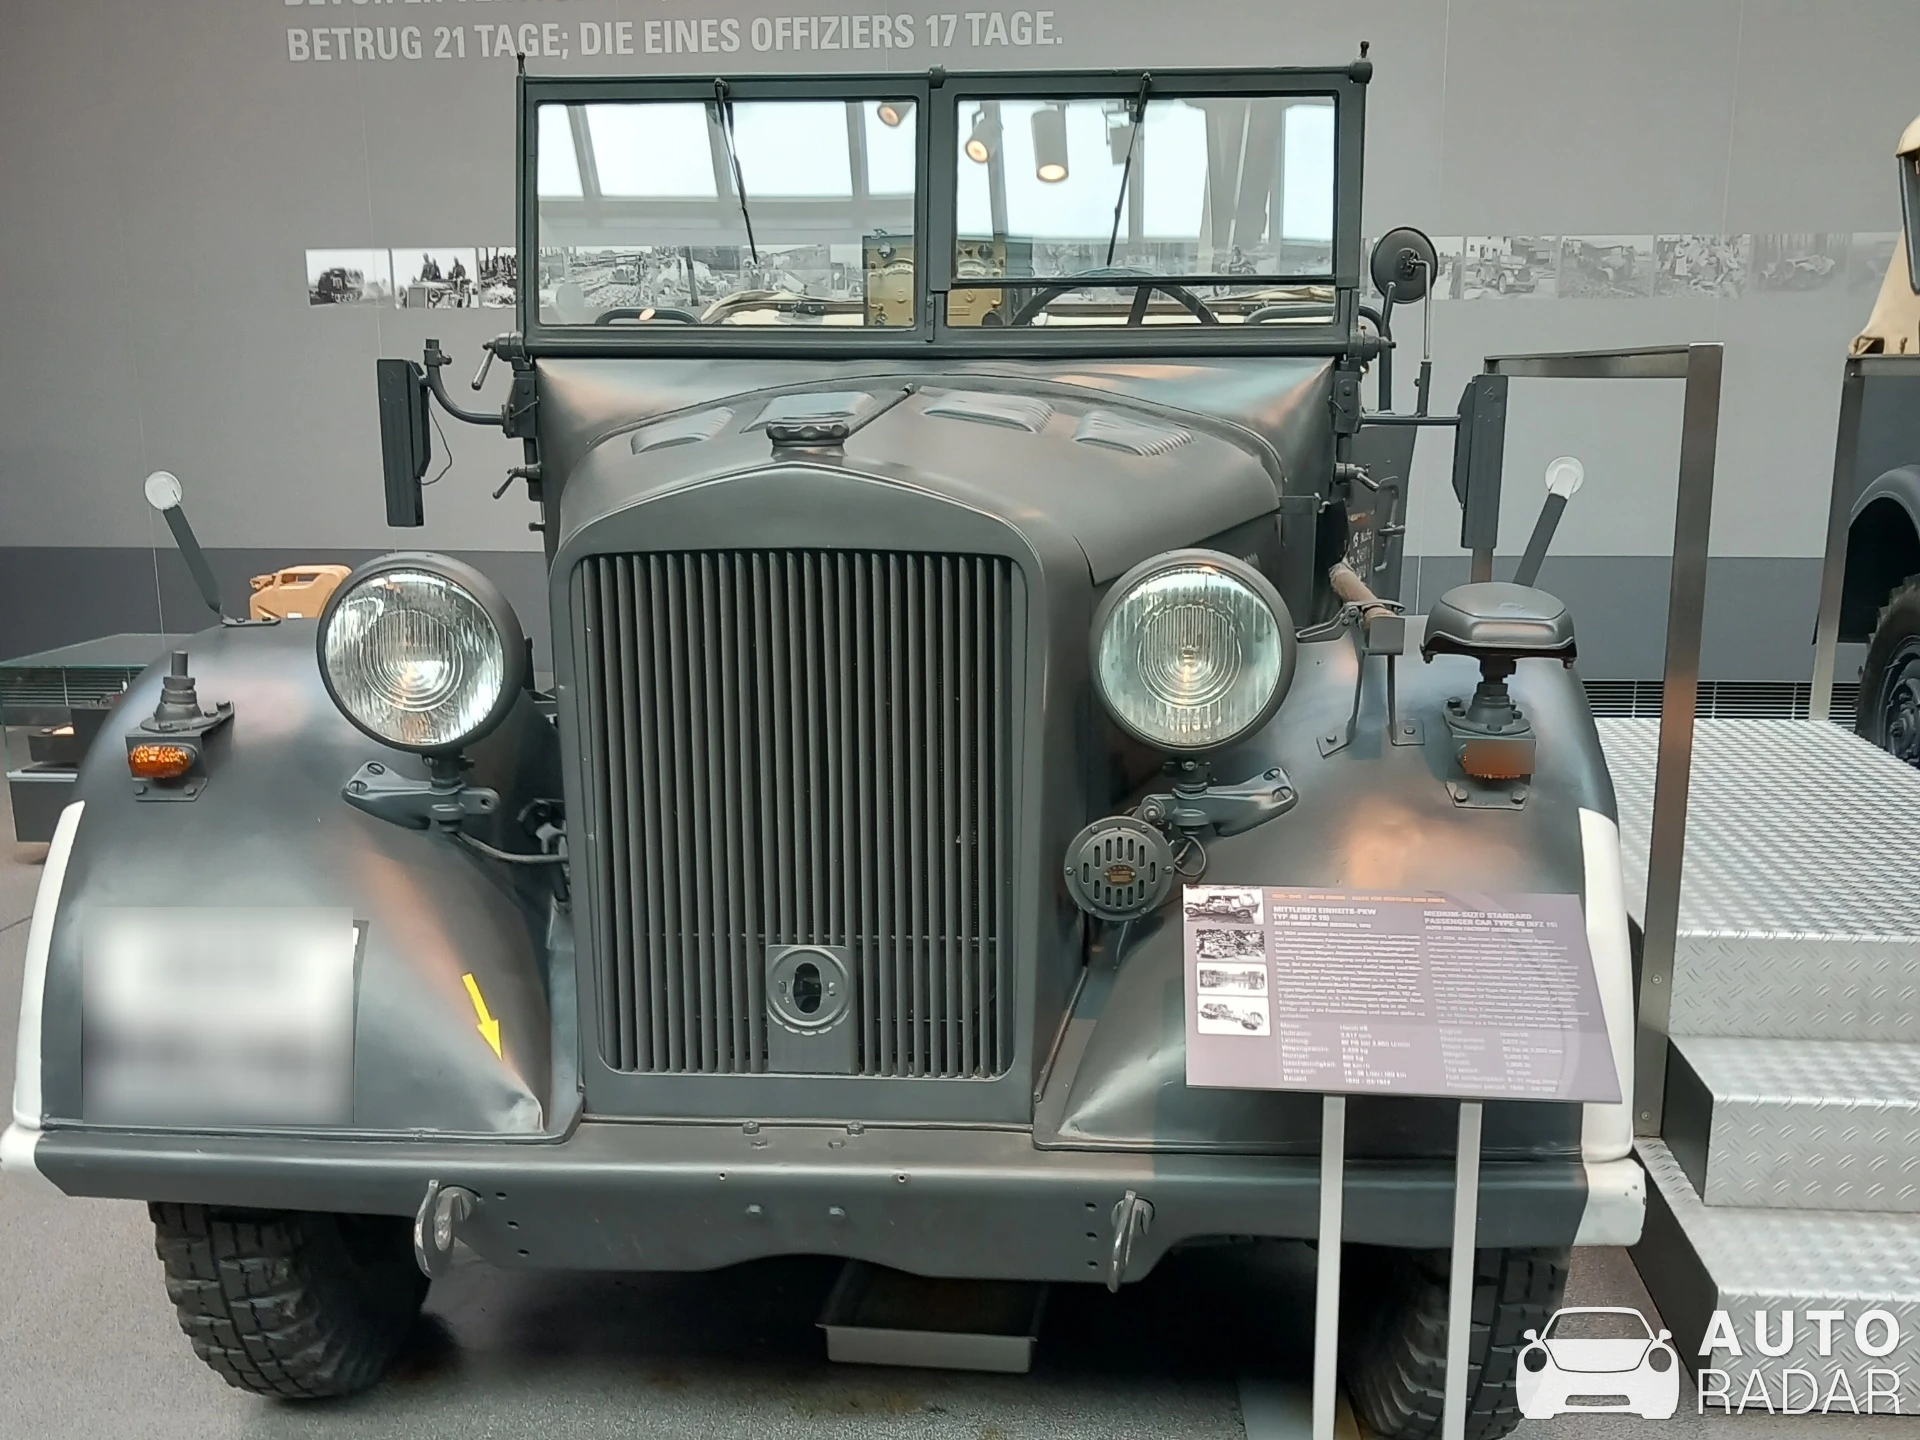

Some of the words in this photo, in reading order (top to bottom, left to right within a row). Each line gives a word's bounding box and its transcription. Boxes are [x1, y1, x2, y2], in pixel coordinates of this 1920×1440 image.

[287, 27, 423, 61] BETRUG
[433, 26, 466, 59] 21
[474, 23, 570, 60] TAGE;
[579, 22, 635, 56] DIE
[644, 18, 741, 54] EINES
[751, 15, 915, 51] OFFIZIERS
[925, 14, 958, 47] 17
[965, 11, 1063, 46] TAGE.
